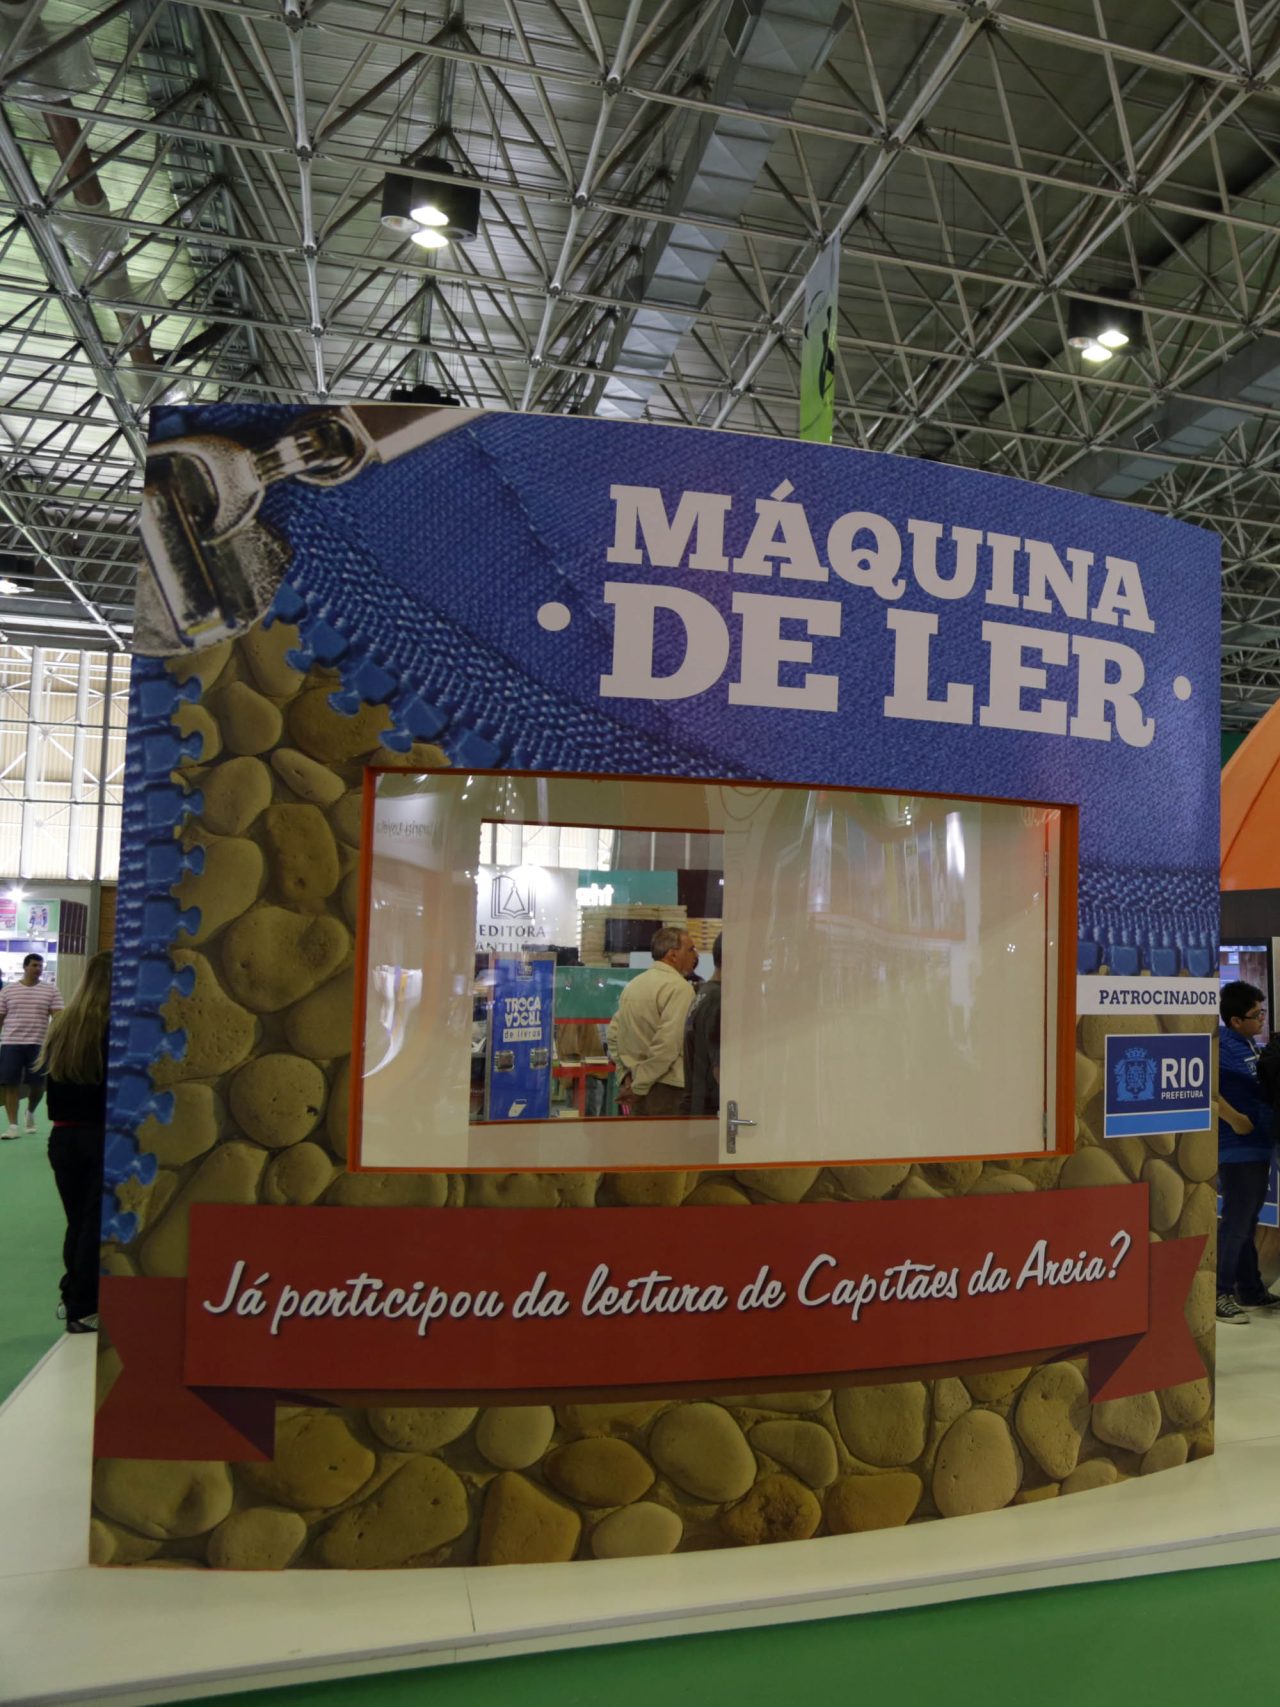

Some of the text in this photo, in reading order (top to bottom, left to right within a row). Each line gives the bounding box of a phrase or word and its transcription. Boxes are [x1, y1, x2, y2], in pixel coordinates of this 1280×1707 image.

[607, 478, 1155, 634] MÁQUINA
[600, 581, 1155, 748] DE LER
[479, 924, 546, 938] EDITORA
[504, 996, 541, 1012] TROCA
[1099, 990, 1217, 1005] PATROCINADOR
[505, 1030, 514, 1039] de
[1161, 1057, 1204, 1089] RIO
[1161, 1090, 1204, 1100] PREFEITURA
[204, 1230, 1131, 1336] Já participou da leitura de Capitães da Areia?
